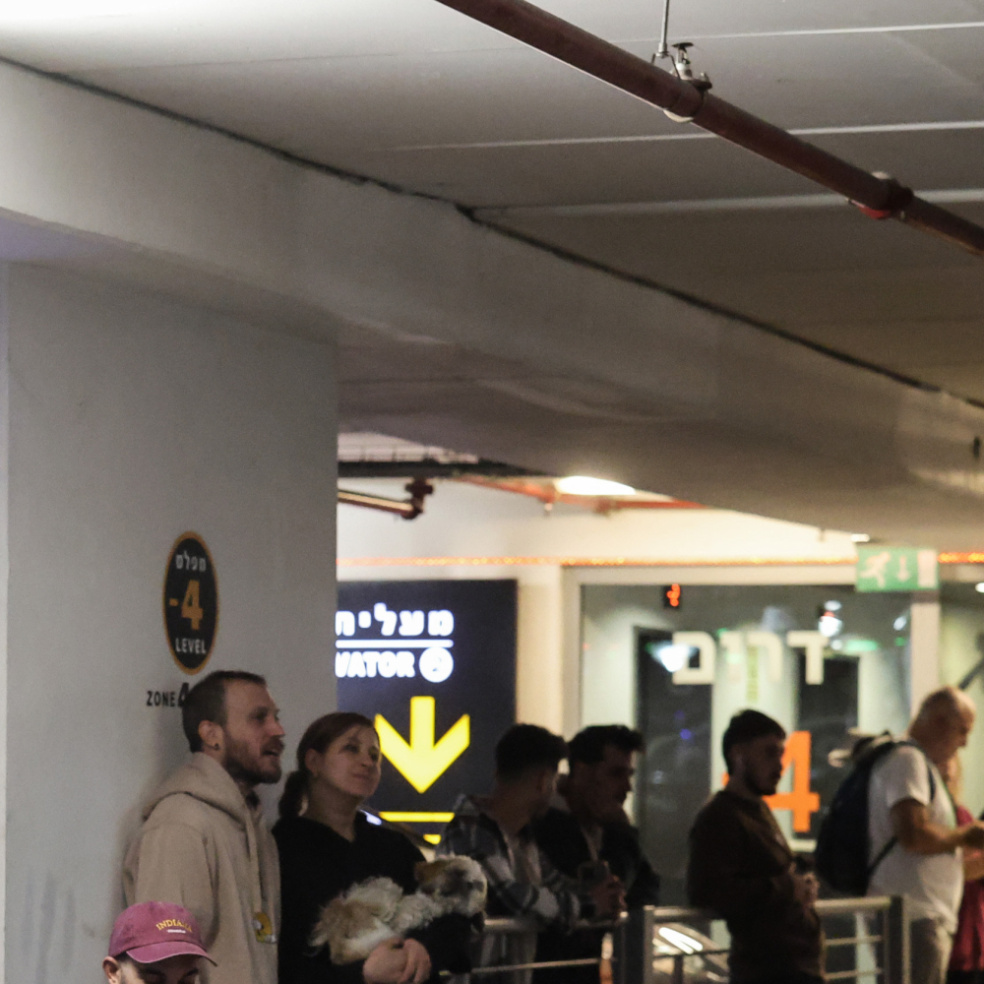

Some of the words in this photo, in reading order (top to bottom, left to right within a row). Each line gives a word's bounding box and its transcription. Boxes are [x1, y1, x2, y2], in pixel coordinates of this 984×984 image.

[169, 579, 204, 631] -4
[175, 637, 207, 655] LEVEL
[146, 690, 176, 708] ZONE
